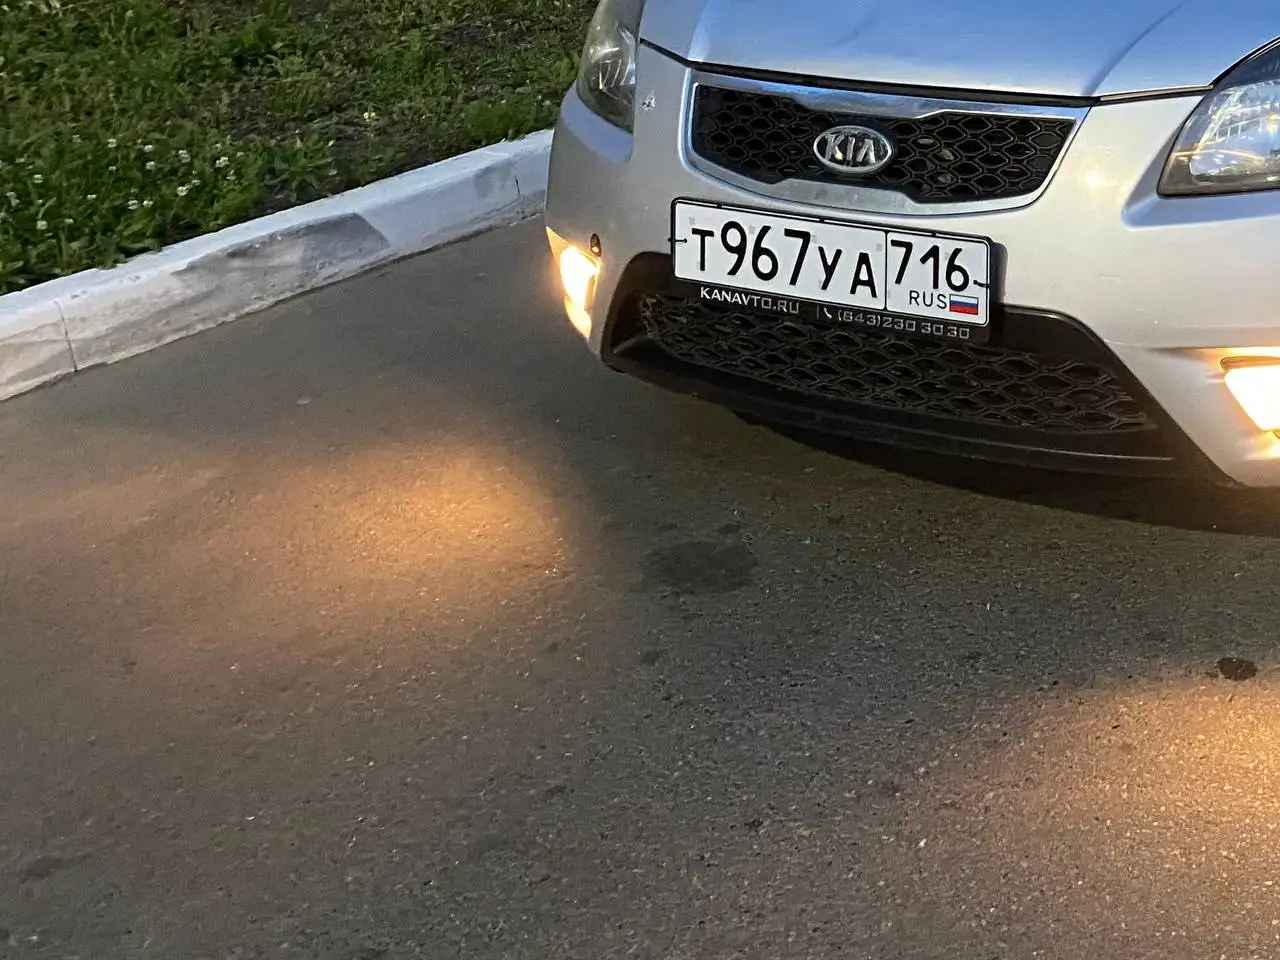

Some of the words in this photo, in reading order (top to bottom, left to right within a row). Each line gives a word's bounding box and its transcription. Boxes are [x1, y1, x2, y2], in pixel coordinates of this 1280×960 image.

[824, 132, 876, 163] KIA
[691, 220, 878, 299] Т967УА
[890, 239, 970, 293] 716
[700, 286, 799, 314] KANAVTO.RU
[921, 322, 944, 336] 30
[947, 326, 970, 339] 30
[909, 290, 947, 310] RUS
